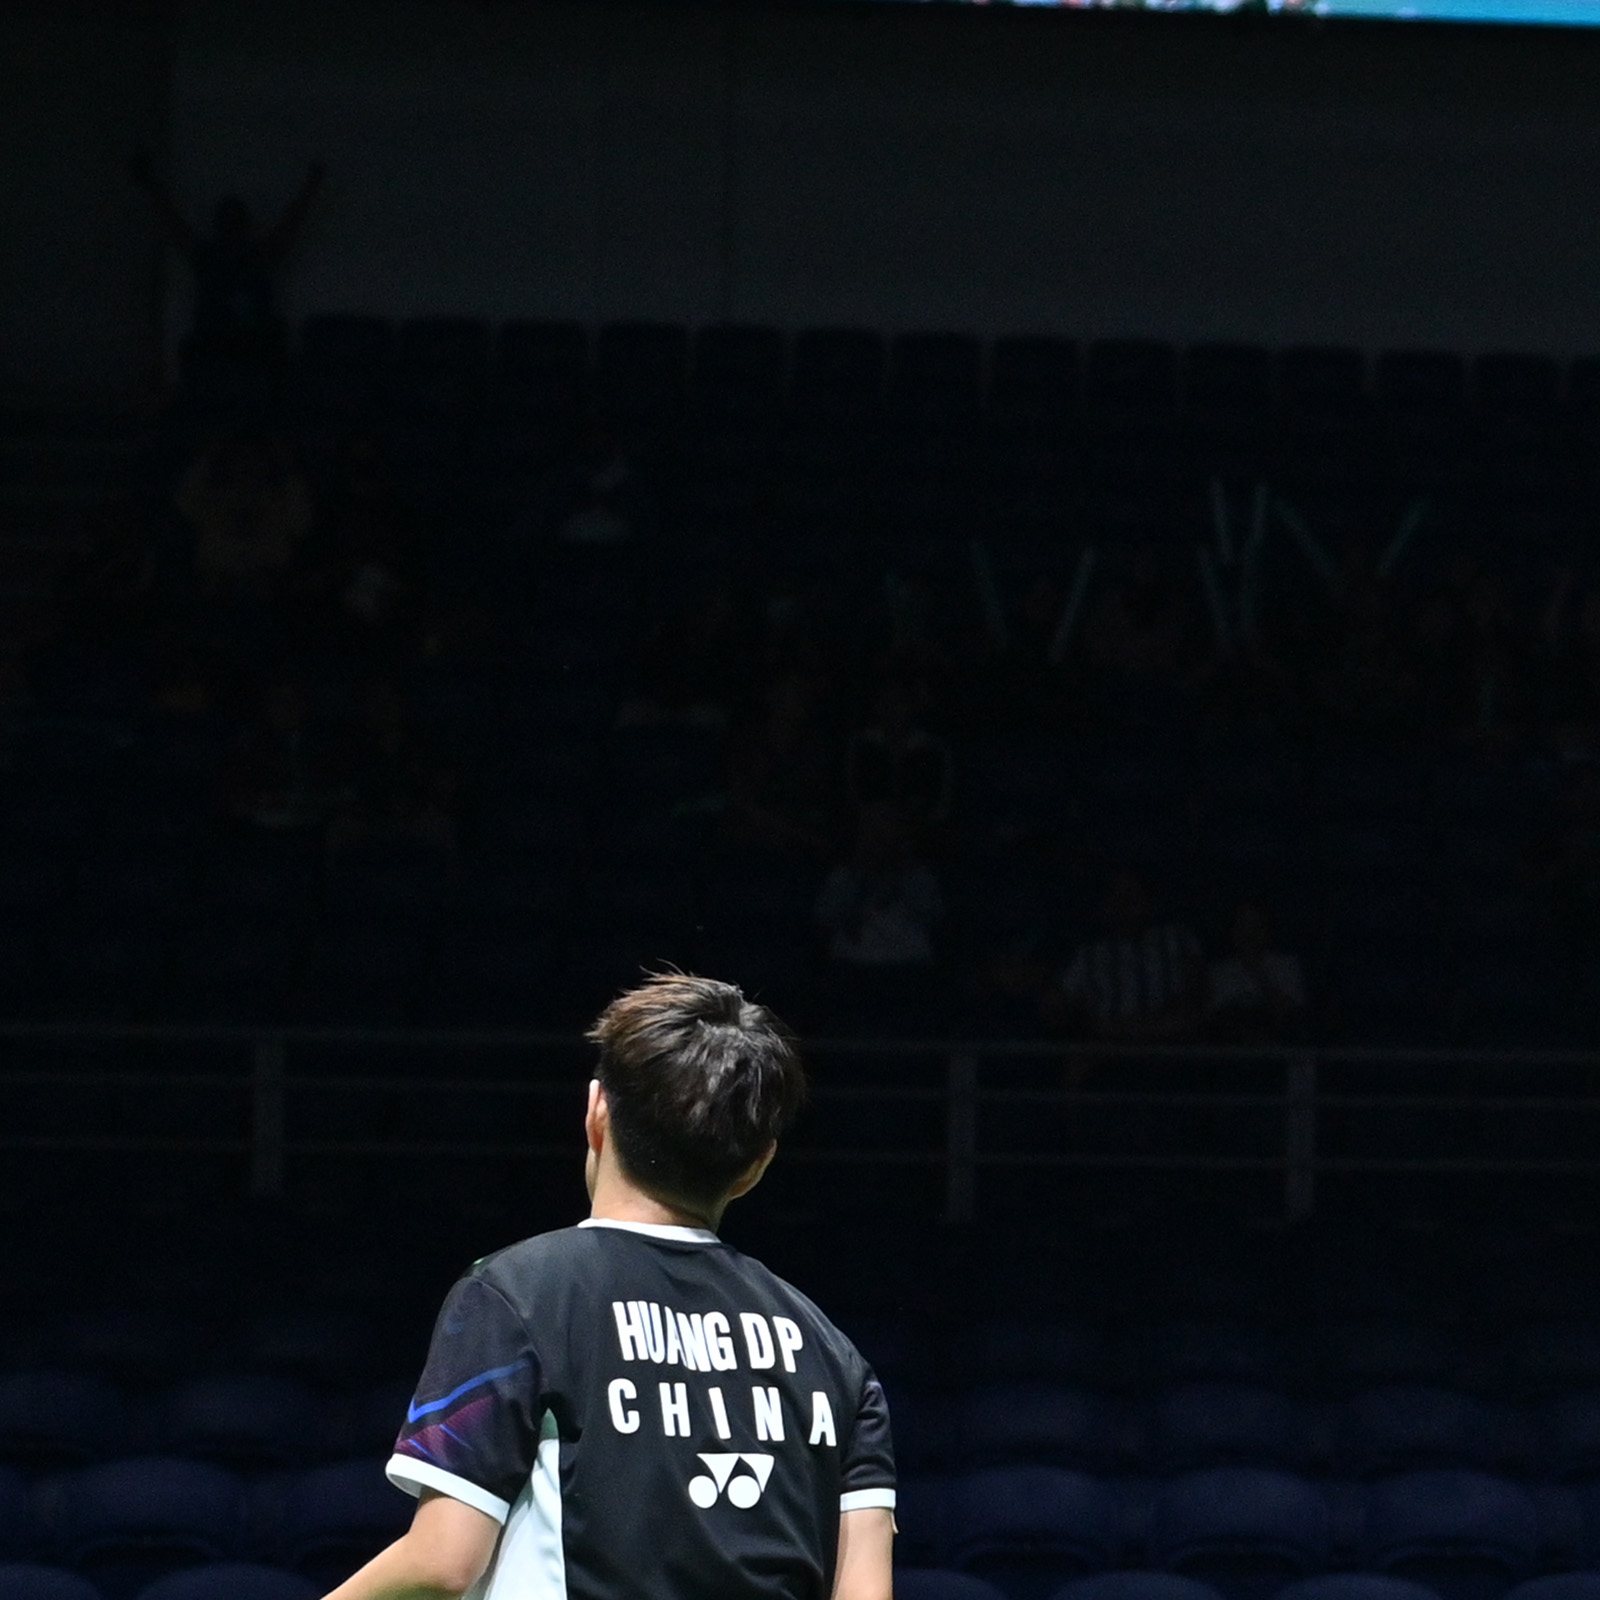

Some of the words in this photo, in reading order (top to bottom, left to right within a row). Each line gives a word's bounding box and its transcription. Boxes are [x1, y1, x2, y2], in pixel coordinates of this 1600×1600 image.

[612, 1301, 737, 1372] HUANG
[739, 1312, 803, 1373] DP
[608, 1378, 837, 1447] CHINA
